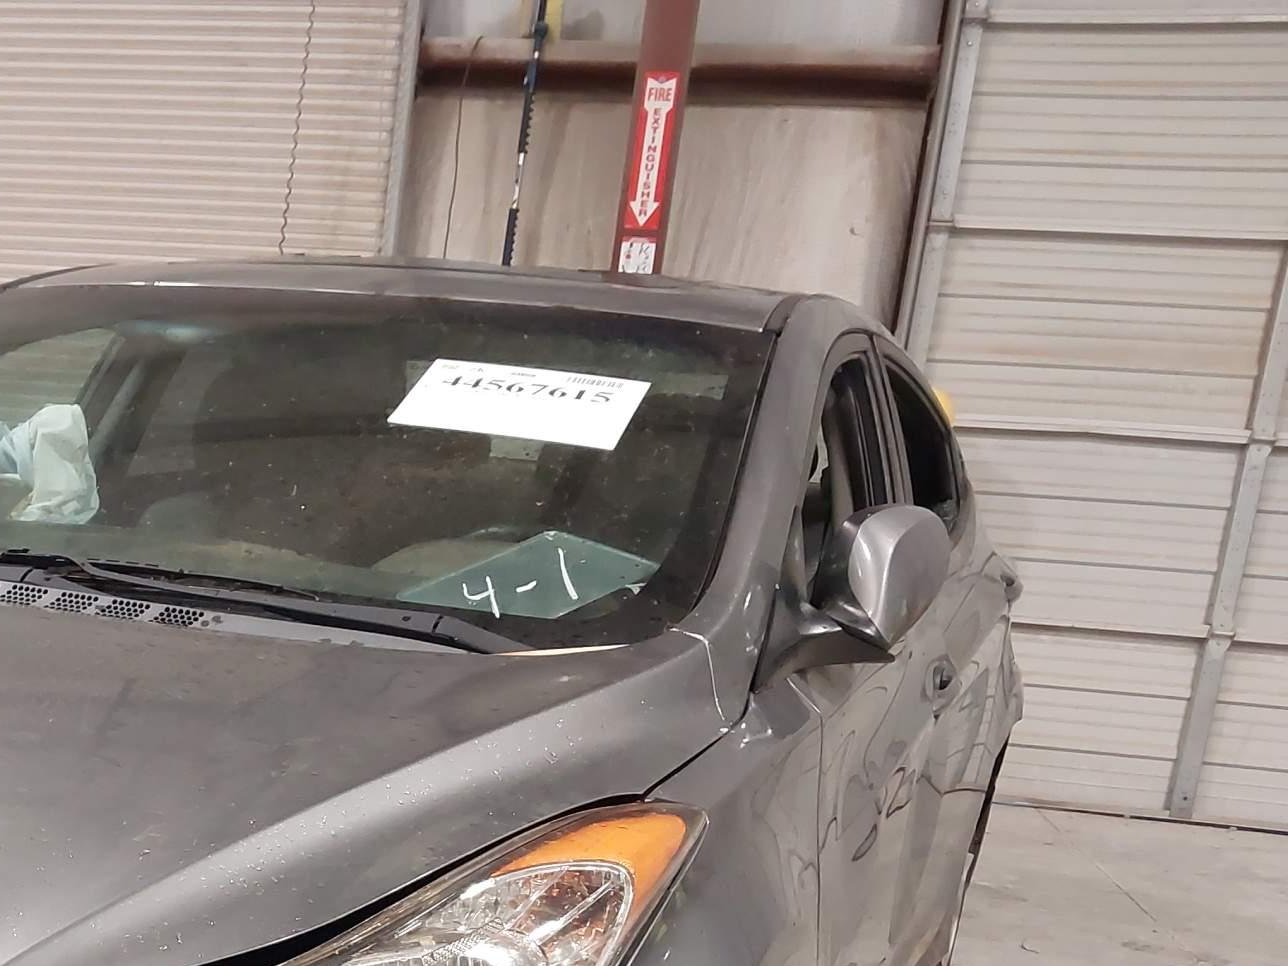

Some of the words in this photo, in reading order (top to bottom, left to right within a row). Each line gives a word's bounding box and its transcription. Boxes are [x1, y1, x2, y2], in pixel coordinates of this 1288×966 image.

[648, 87, 673, 101] FIRE
[639, 108, 662, 216] EXTINGUISHER
[442, 376, 614, 403] 44567615
